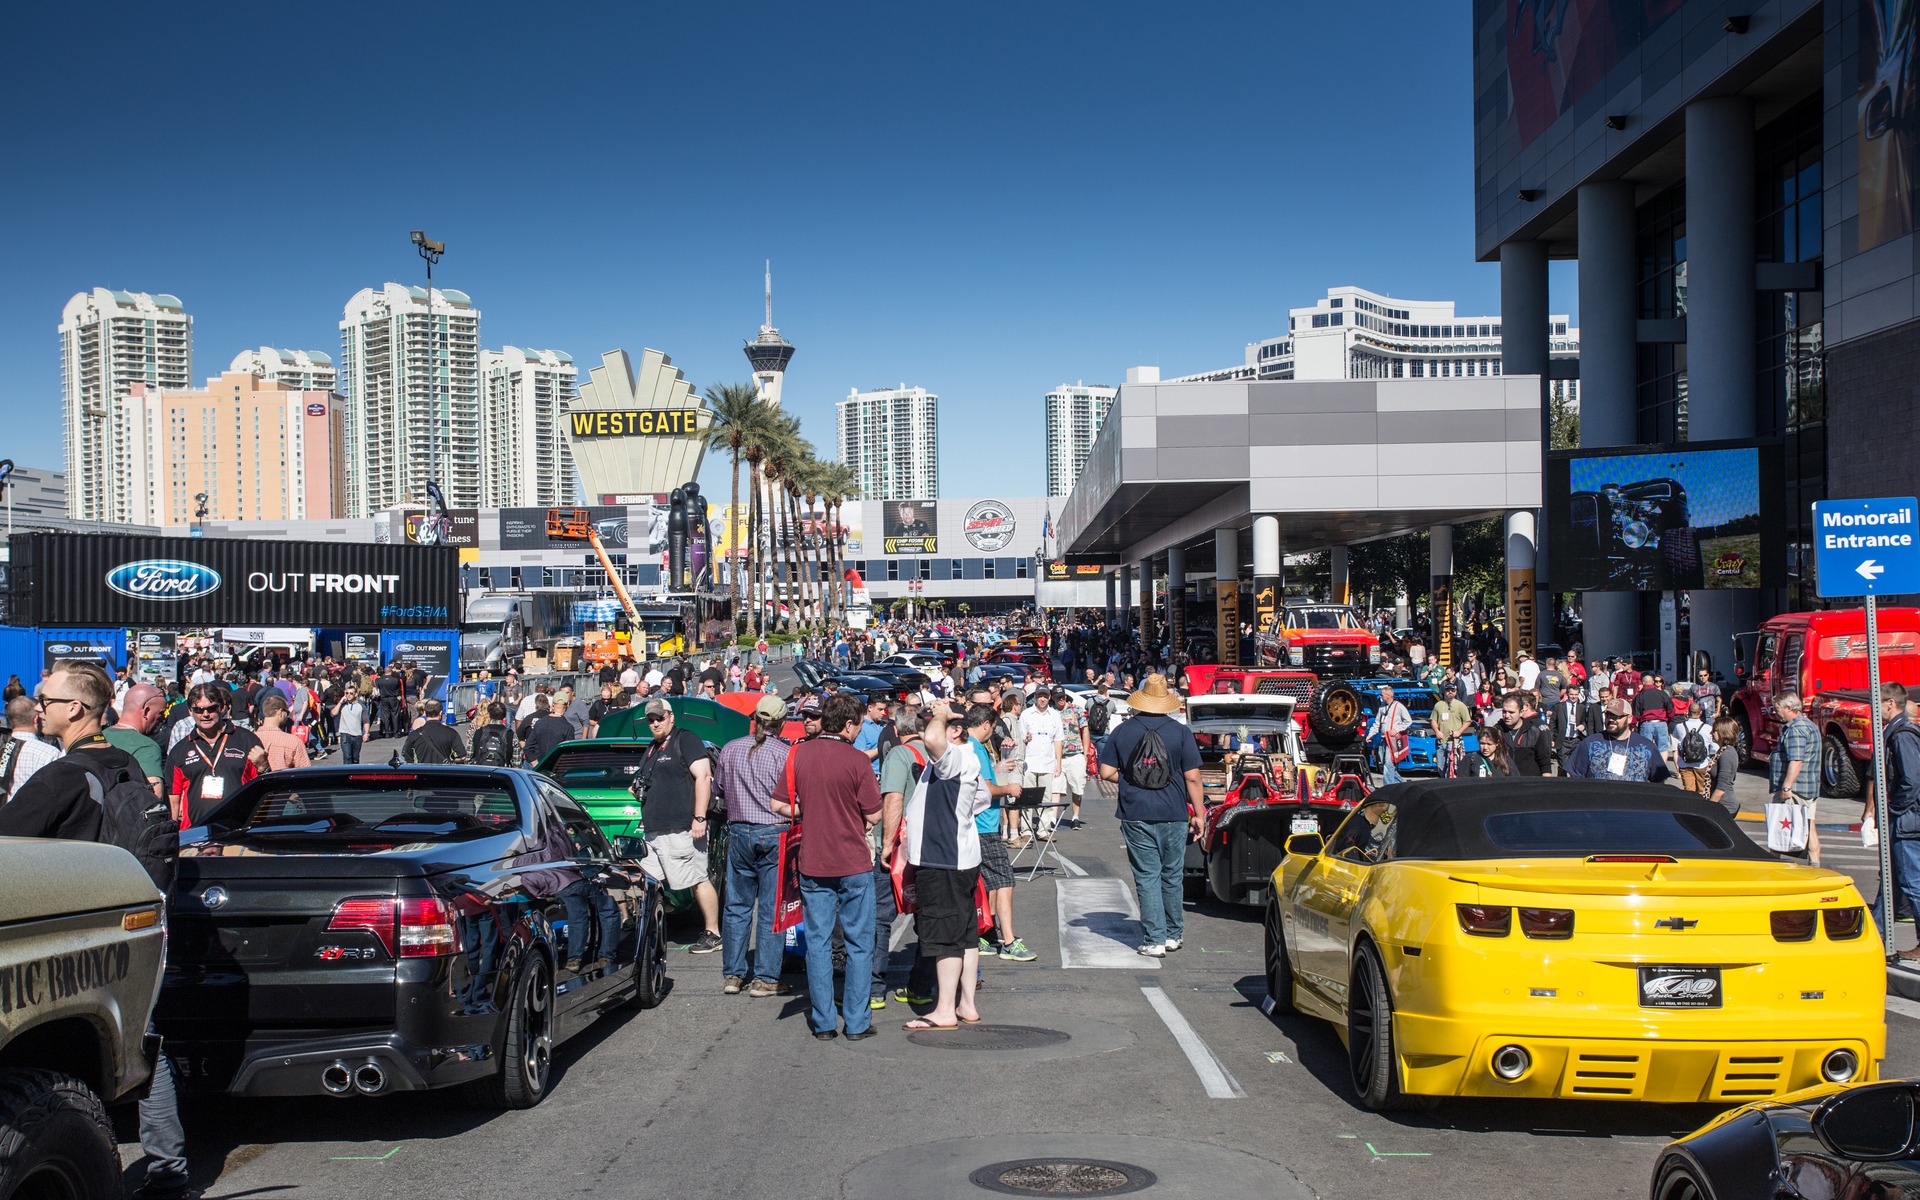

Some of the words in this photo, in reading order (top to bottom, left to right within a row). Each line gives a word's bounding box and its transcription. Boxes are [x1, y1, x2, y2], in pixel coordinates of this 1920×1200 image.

[572, 411, 695, 435] WESTGATE
[454, 516, 475, 524] tune
[1823, 508, 1911, 527] Monorail
[1825, 533, 1912, 549] Entrance
[129, 564, 197, 595] Ford
[248, 571, 304, 593] OUT
[309, 573, 400, 593] FRONT
[380, 605, 448, 618] #FordSEMA
[249, 631, 265, 640] SONY
[47, 940, 131, 1002] BRONCO
[1644, 975, 1717, 995] KAO
